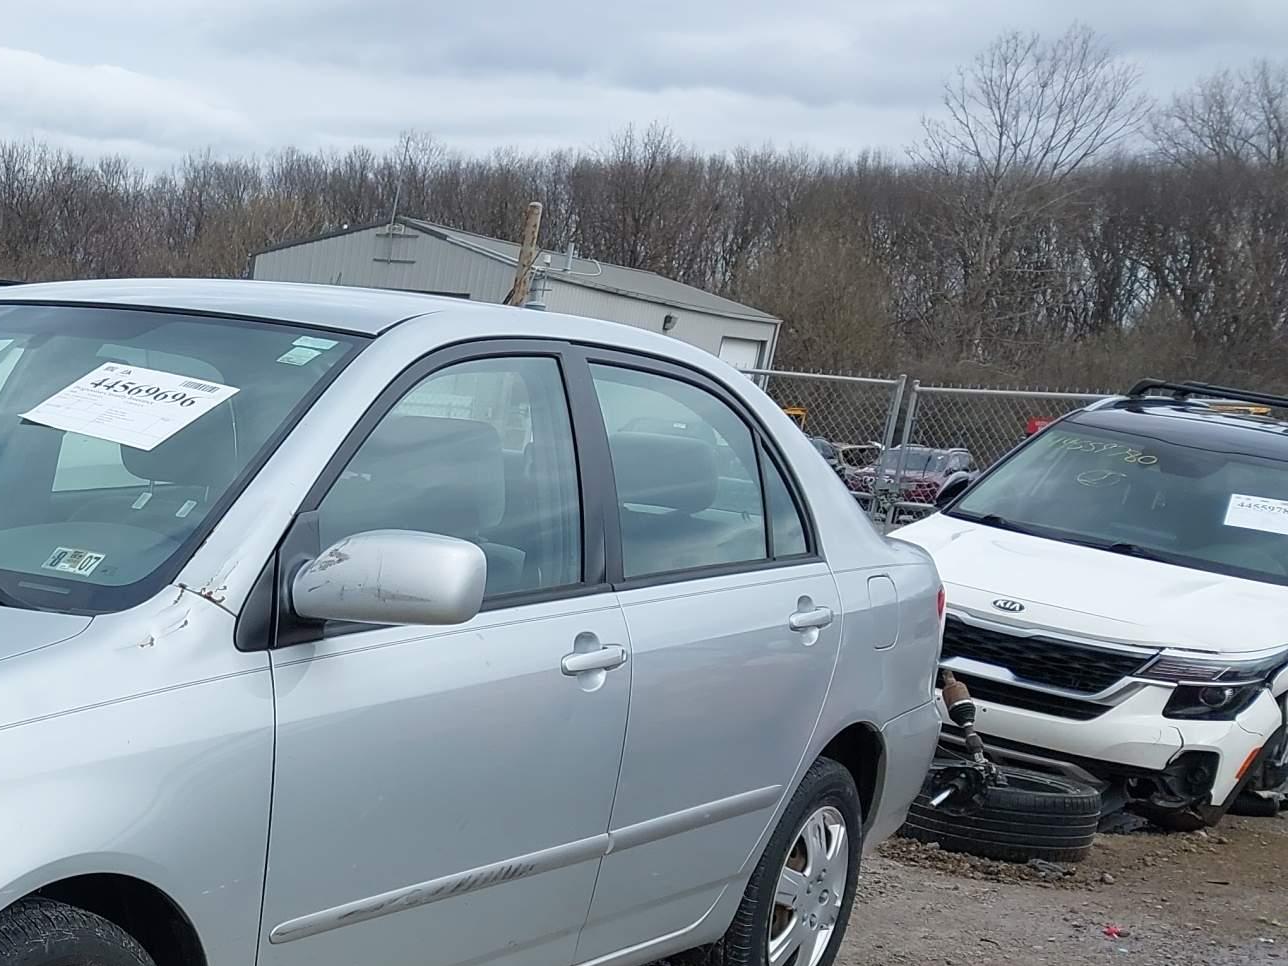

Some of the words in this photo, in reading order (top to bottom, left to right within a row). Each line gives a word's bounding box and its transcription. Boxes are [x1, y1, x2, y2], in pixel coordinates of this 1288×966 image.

[89, 377, 202, 408] 44569696
[78, 555, 101, 571] 07
[995, 600, 1021, 611] KIA
